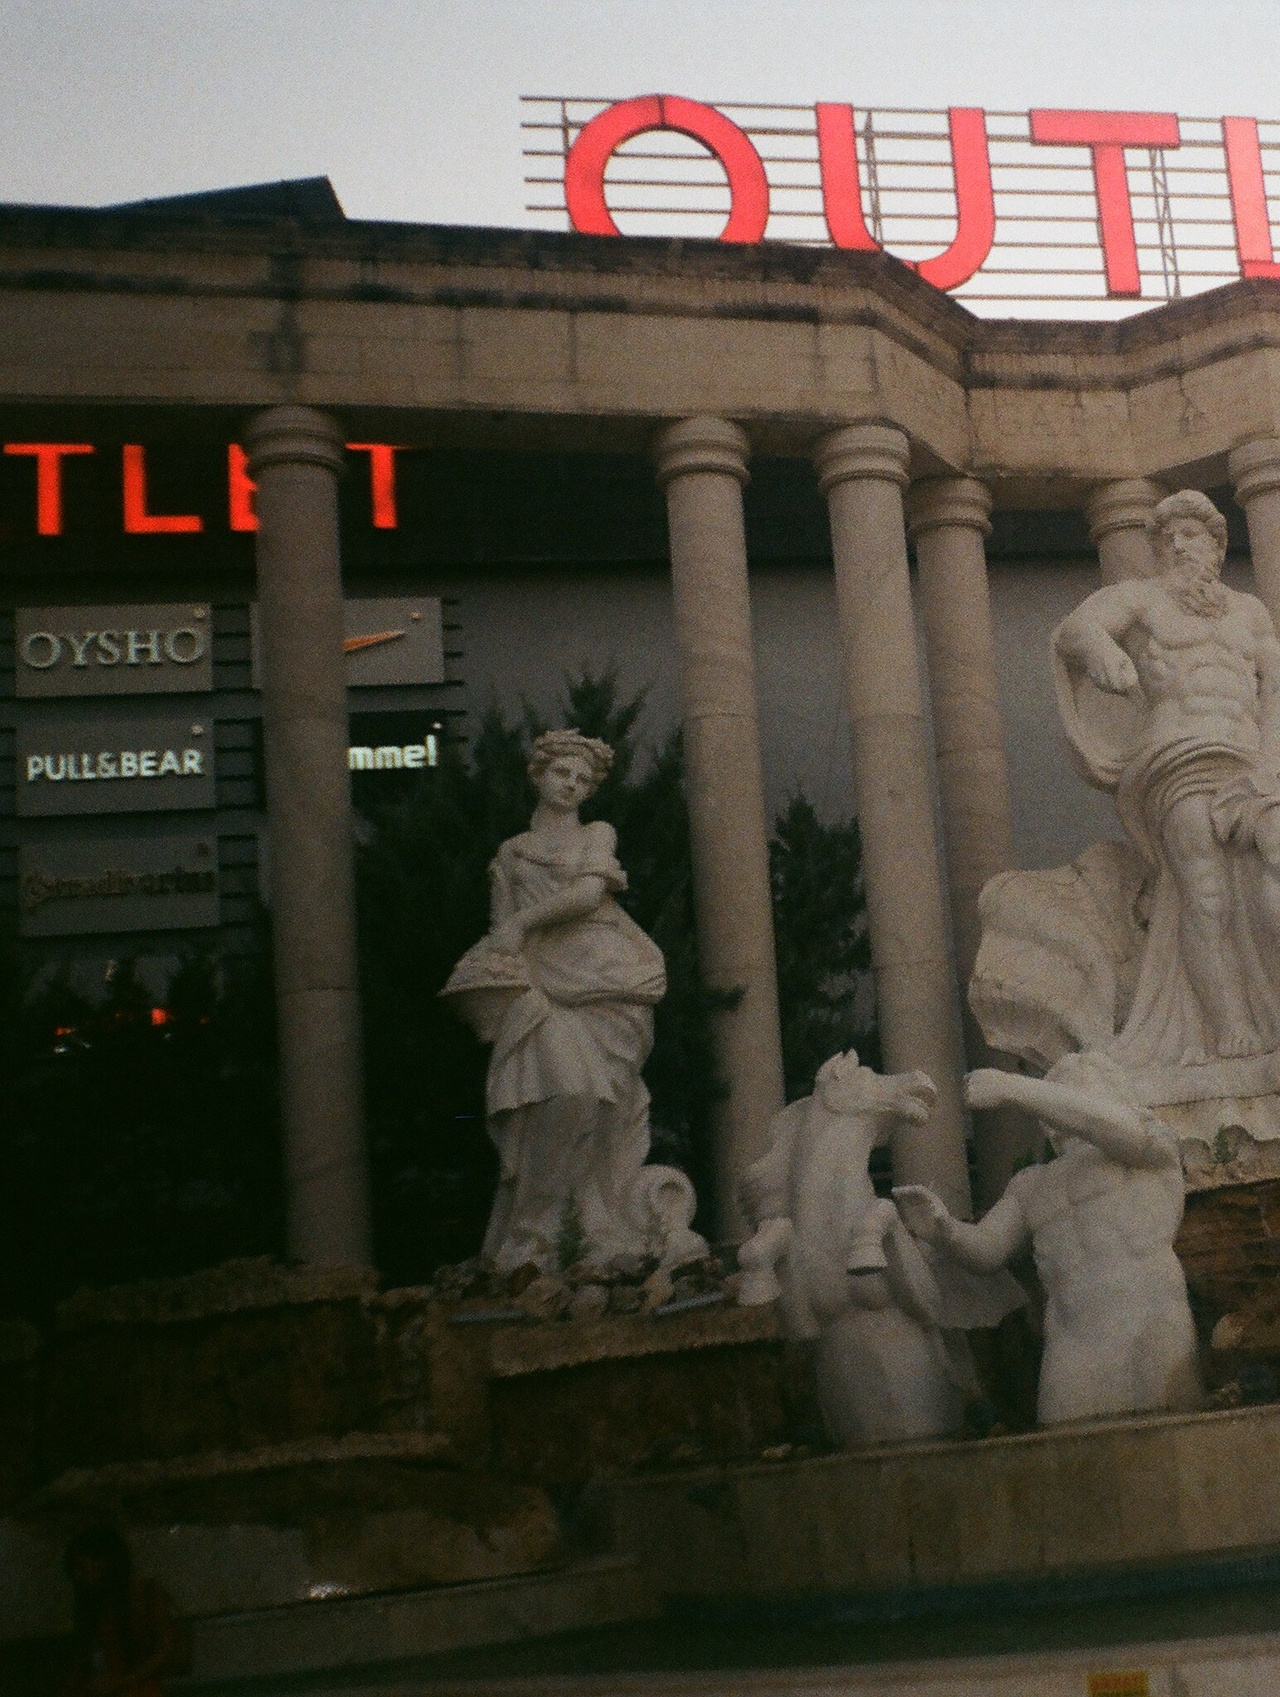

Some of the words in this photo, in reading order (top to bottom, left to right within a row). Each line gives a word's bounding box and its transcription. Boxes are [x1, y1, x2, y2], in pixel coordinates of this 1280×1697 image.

[20, 629, 203, 669] OYSHO
[26, 749, 202, 781] PULL&BEAR
[346, 733, 437, 770] mmel
